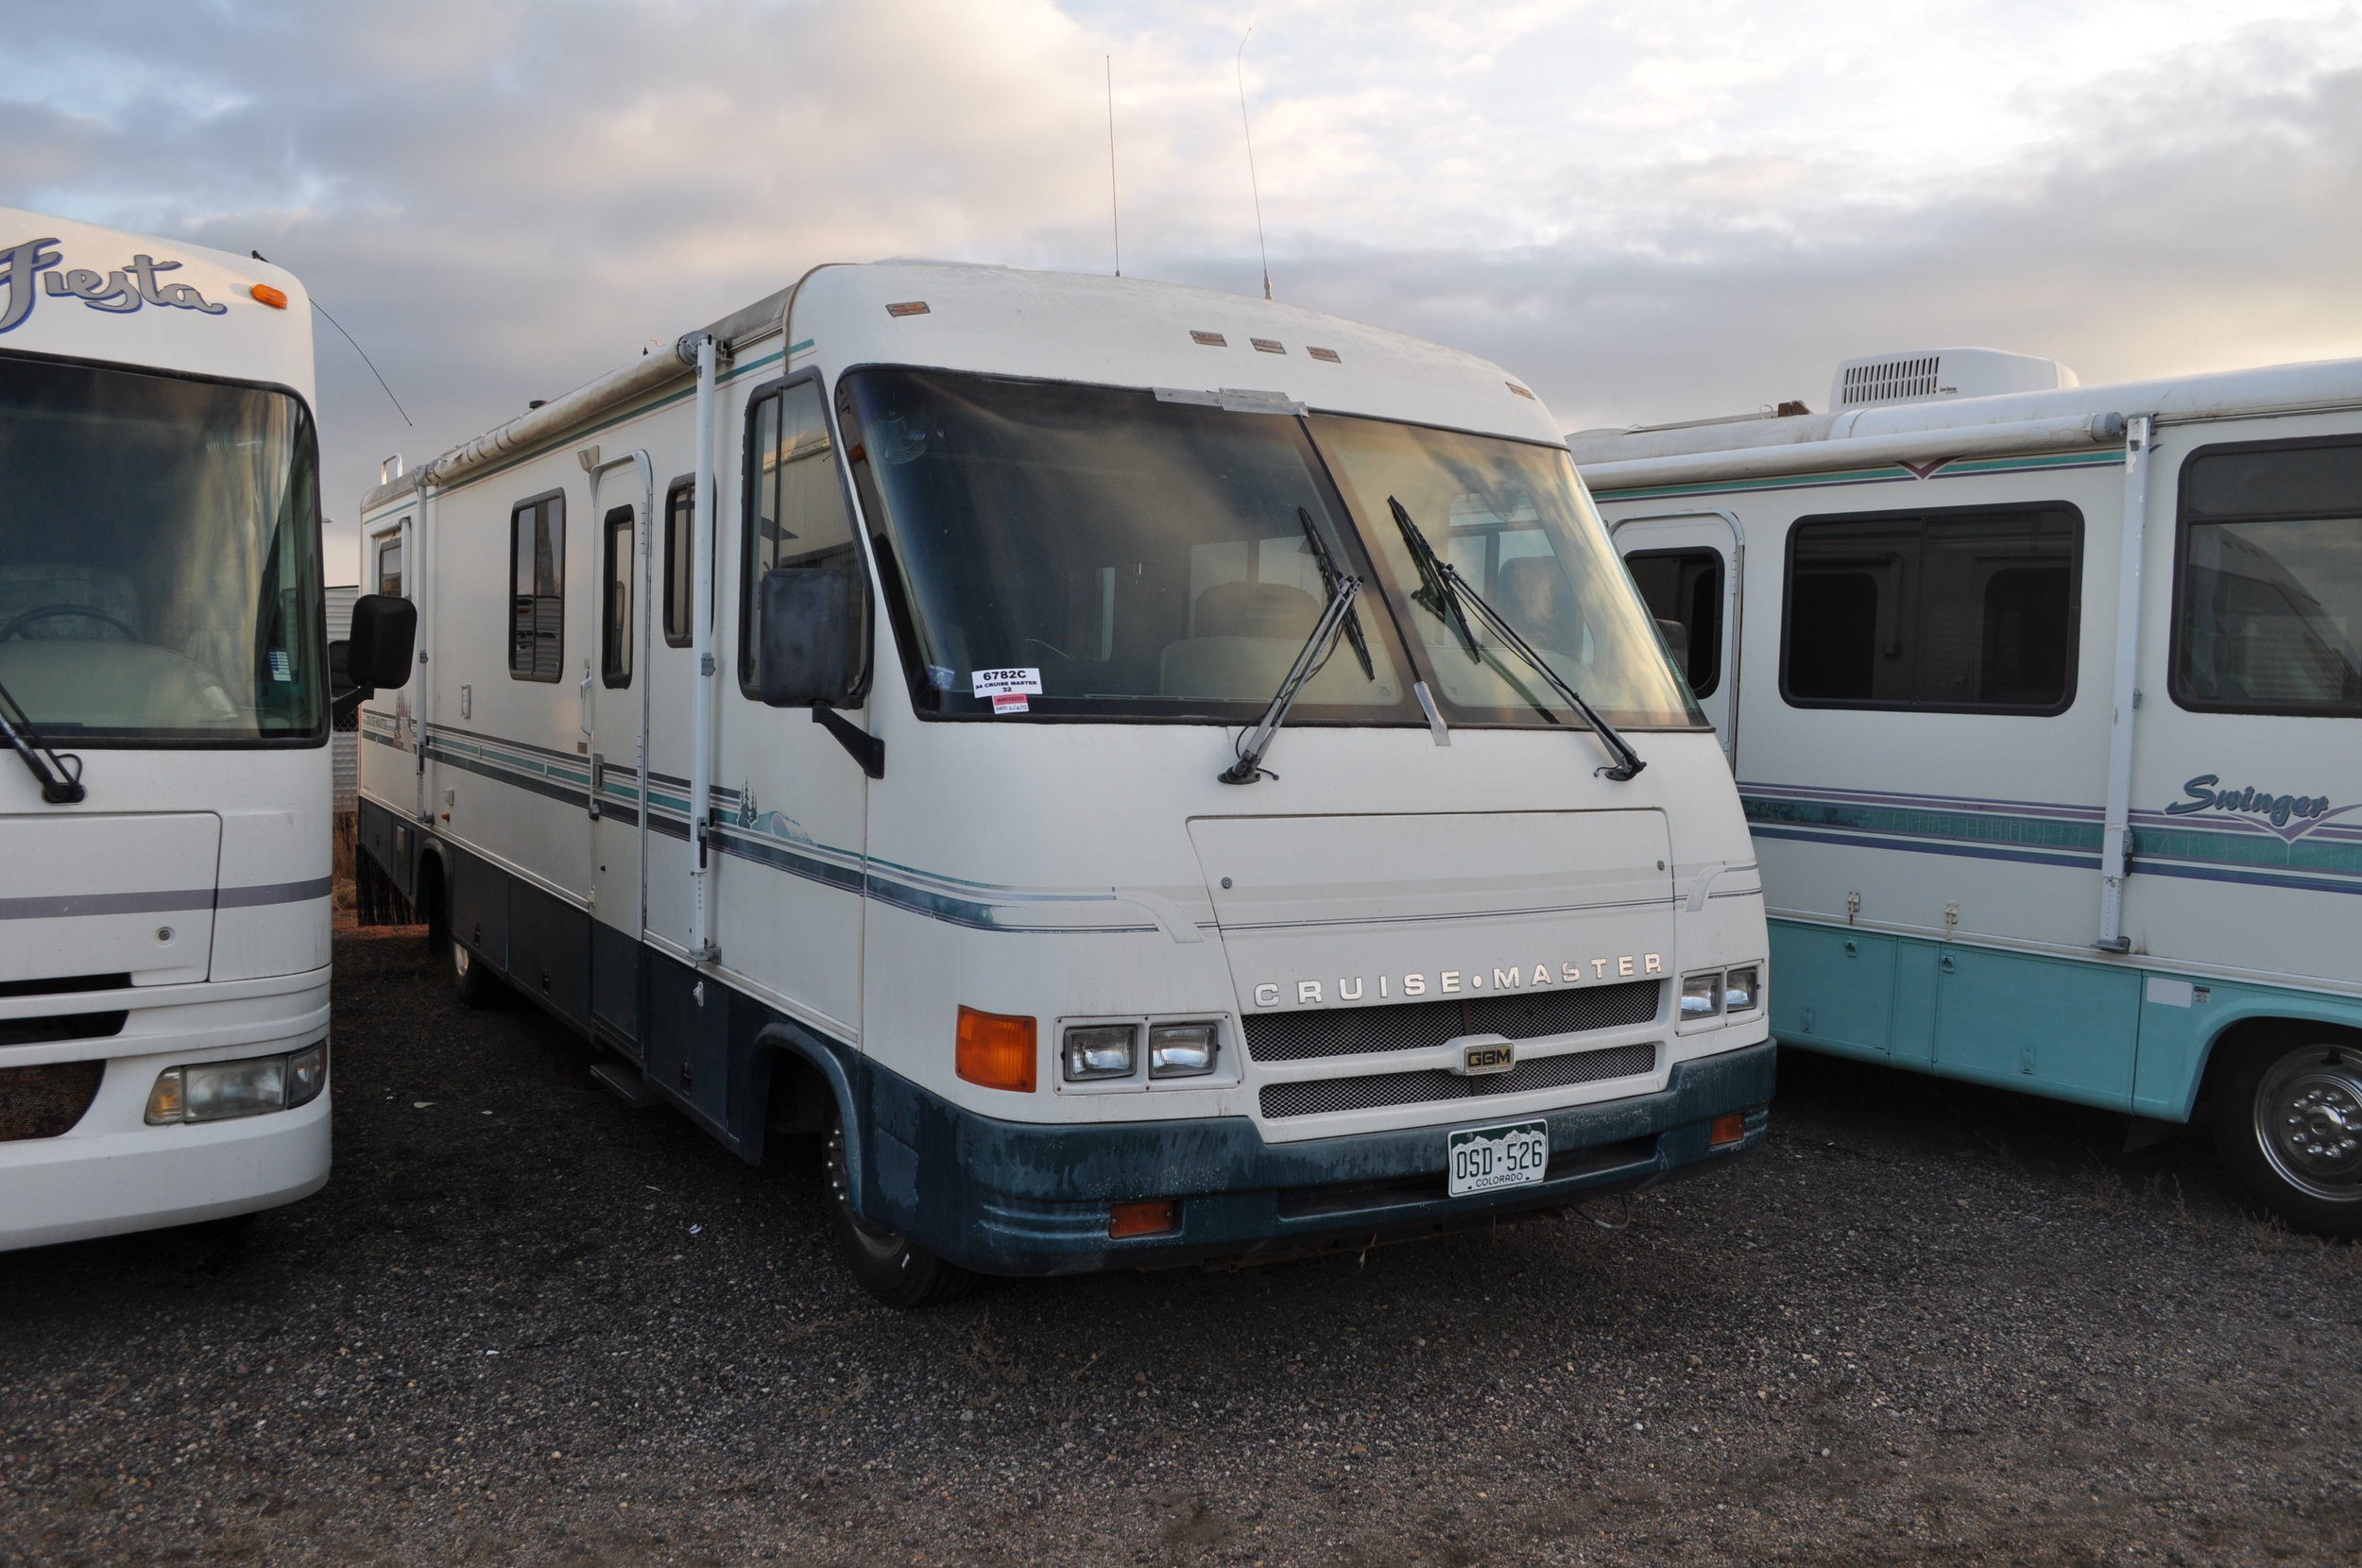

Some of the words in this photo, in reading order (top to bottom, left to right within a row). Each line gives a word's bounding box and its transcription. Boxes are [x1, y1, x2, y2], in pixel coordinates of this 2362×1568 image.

[0, 237, 228, 334] Fiesta
[984, 671, 1026, 680] 6782C
[2165, 774, 2329, 827] Swinger
[1467, 1048, 1511, 1067] GBM
[1475, 1172, 1523, 1187] COLORADO
